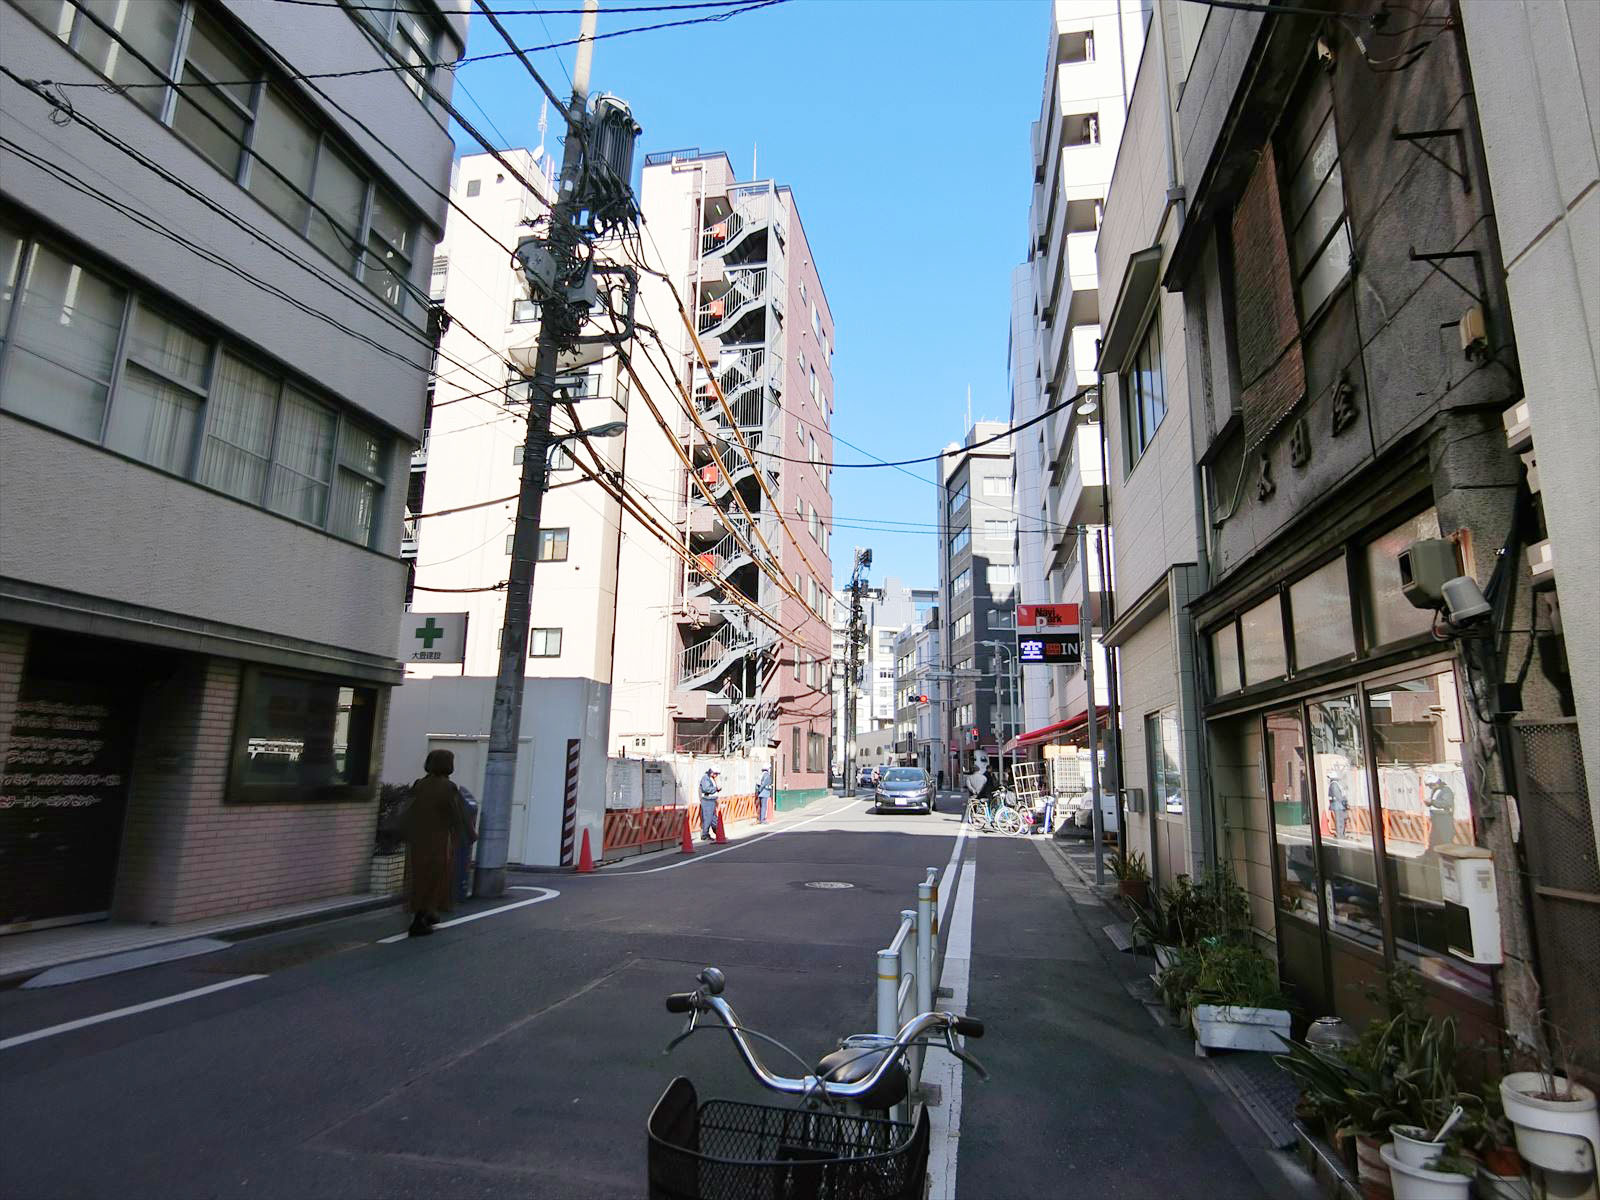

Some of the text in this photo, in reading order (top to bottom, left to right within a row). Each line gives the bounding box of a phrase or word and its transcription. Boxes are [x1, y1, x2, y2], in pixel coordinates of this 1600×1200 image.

[1036, 615, 1062, 633] Park
[1021, 640, 1043, 659] 空
[1061, 642, 1078, 655] IN
